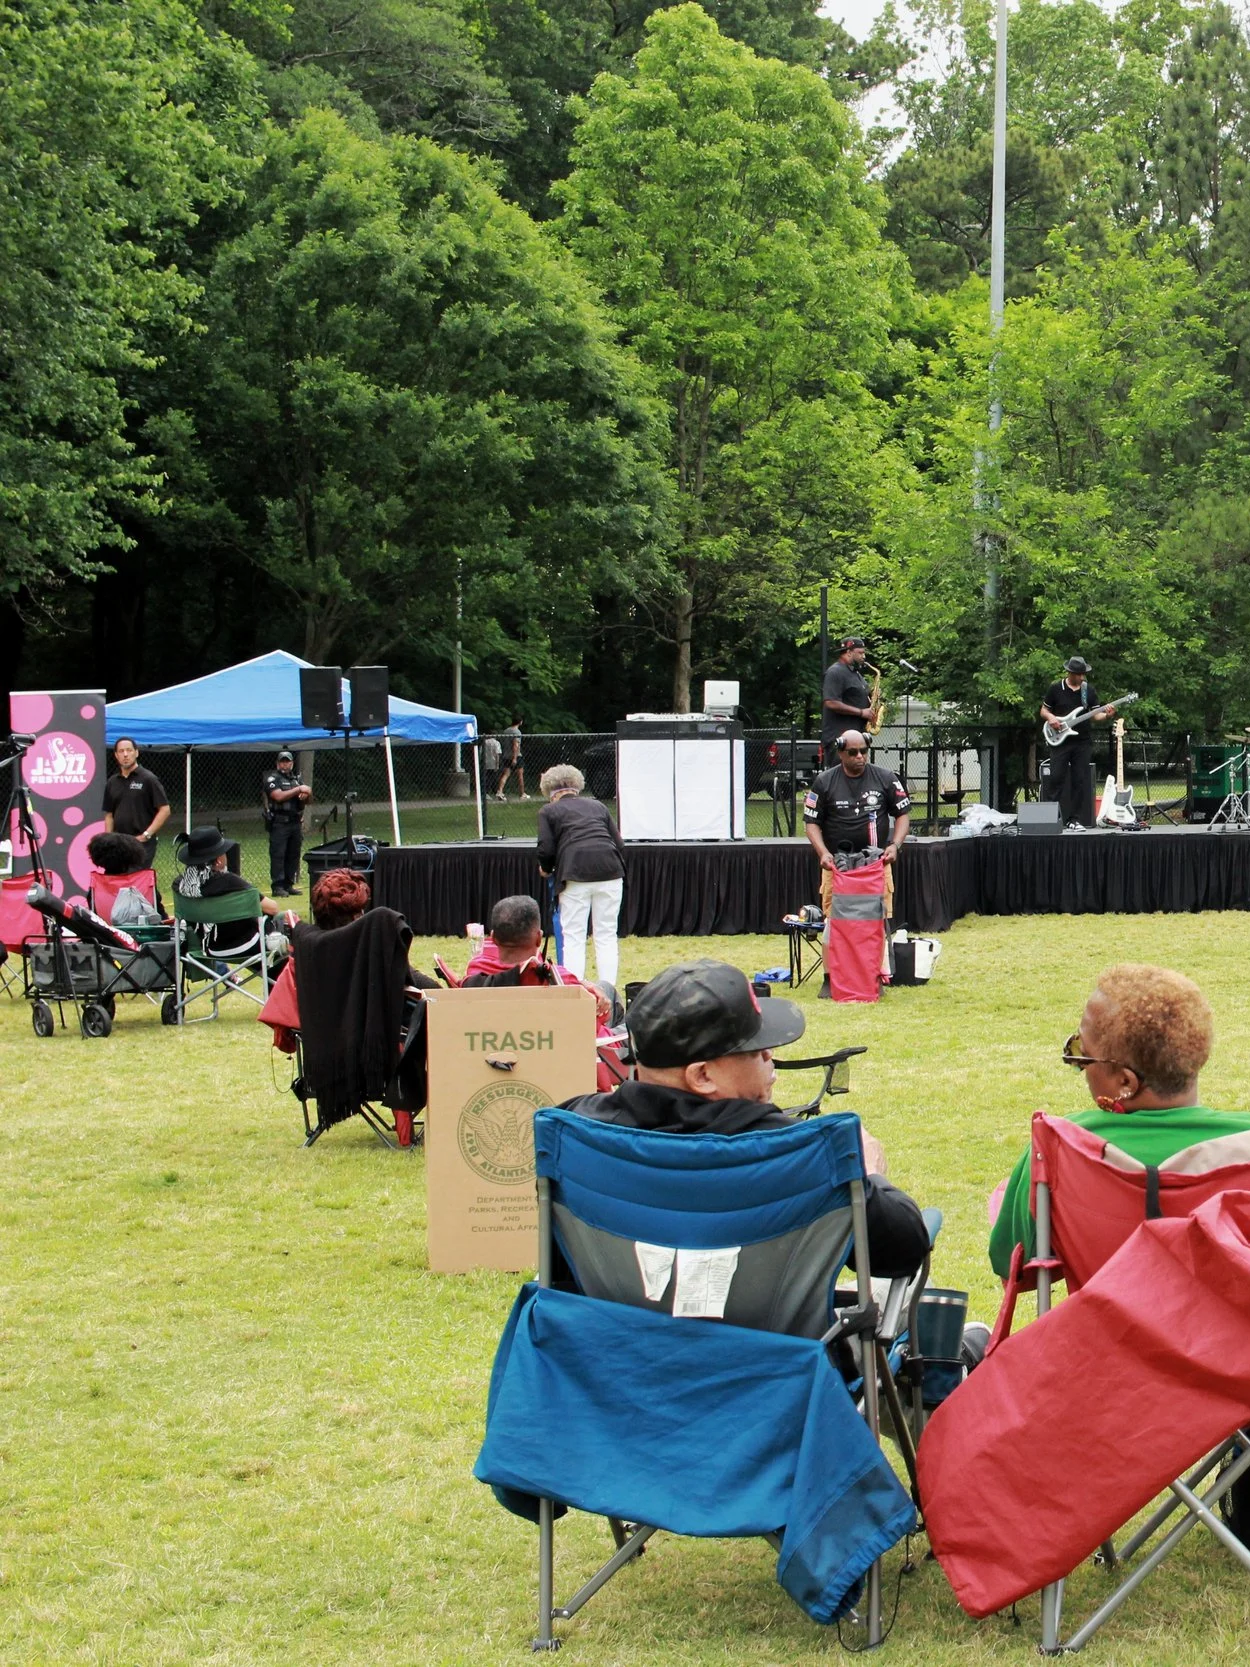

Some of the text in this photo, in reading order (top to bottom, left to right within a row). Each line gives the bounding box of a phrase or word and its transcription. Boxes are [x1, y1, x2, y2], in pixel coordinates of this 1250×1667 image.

[31, 743, 86, 775] JAZZ
[31, 776, 87, 784] FESTIVAL
[464, 1031, 554, 1051] TRASH
[476, 1195, 532, 1204] DEPARTMENT
[500, 1205, 539, 1213] RECREAT
